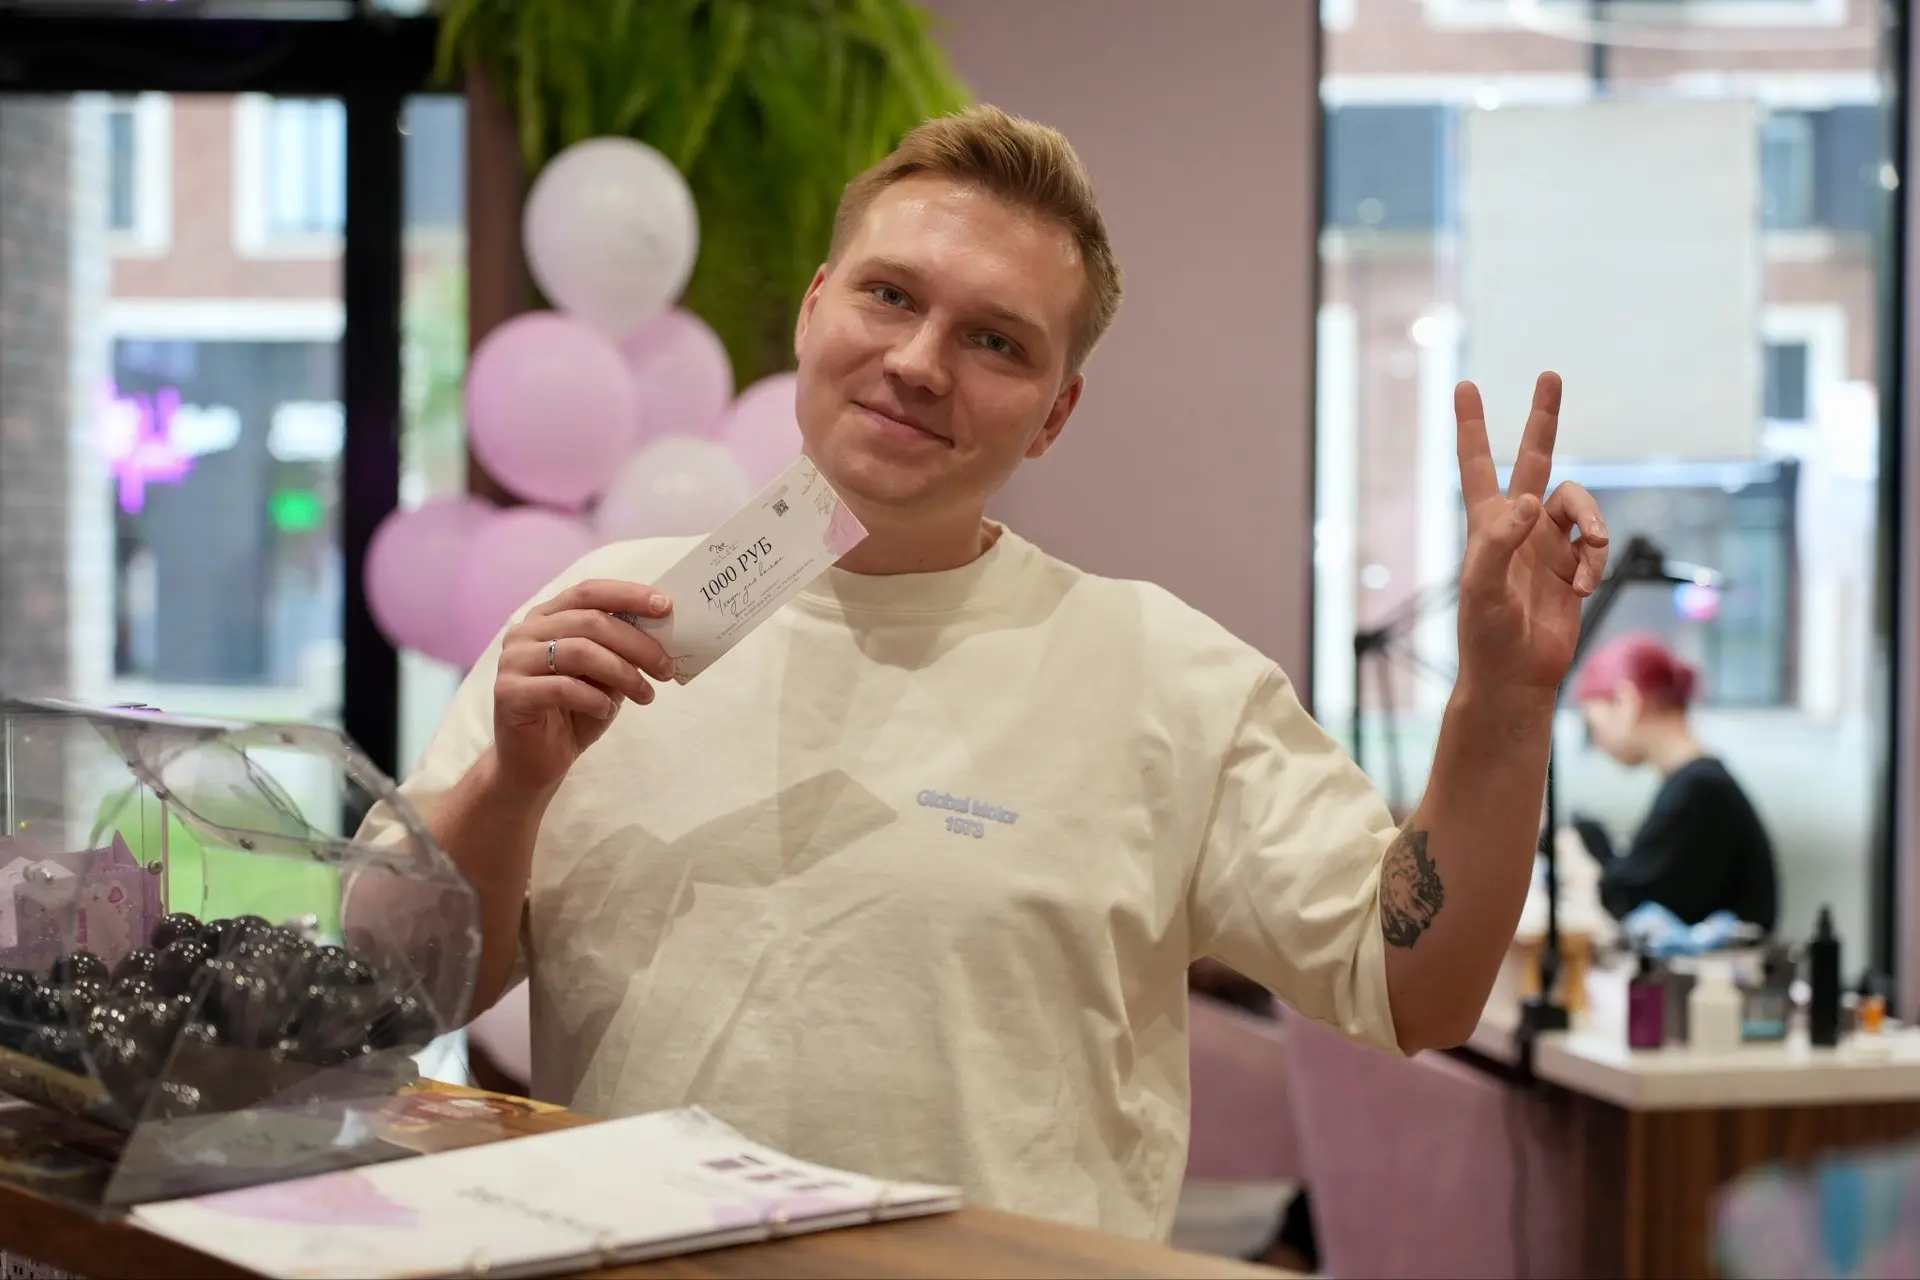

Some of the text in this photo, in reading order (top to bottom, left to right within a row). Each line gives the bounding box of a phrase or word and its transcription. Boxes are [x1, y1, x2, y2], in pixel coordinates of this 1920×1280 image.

[700, 565, 738, 603] 1000
[737, 536, 772, 572] РУБ
[916, 789, 1020, 825] Global Motor
